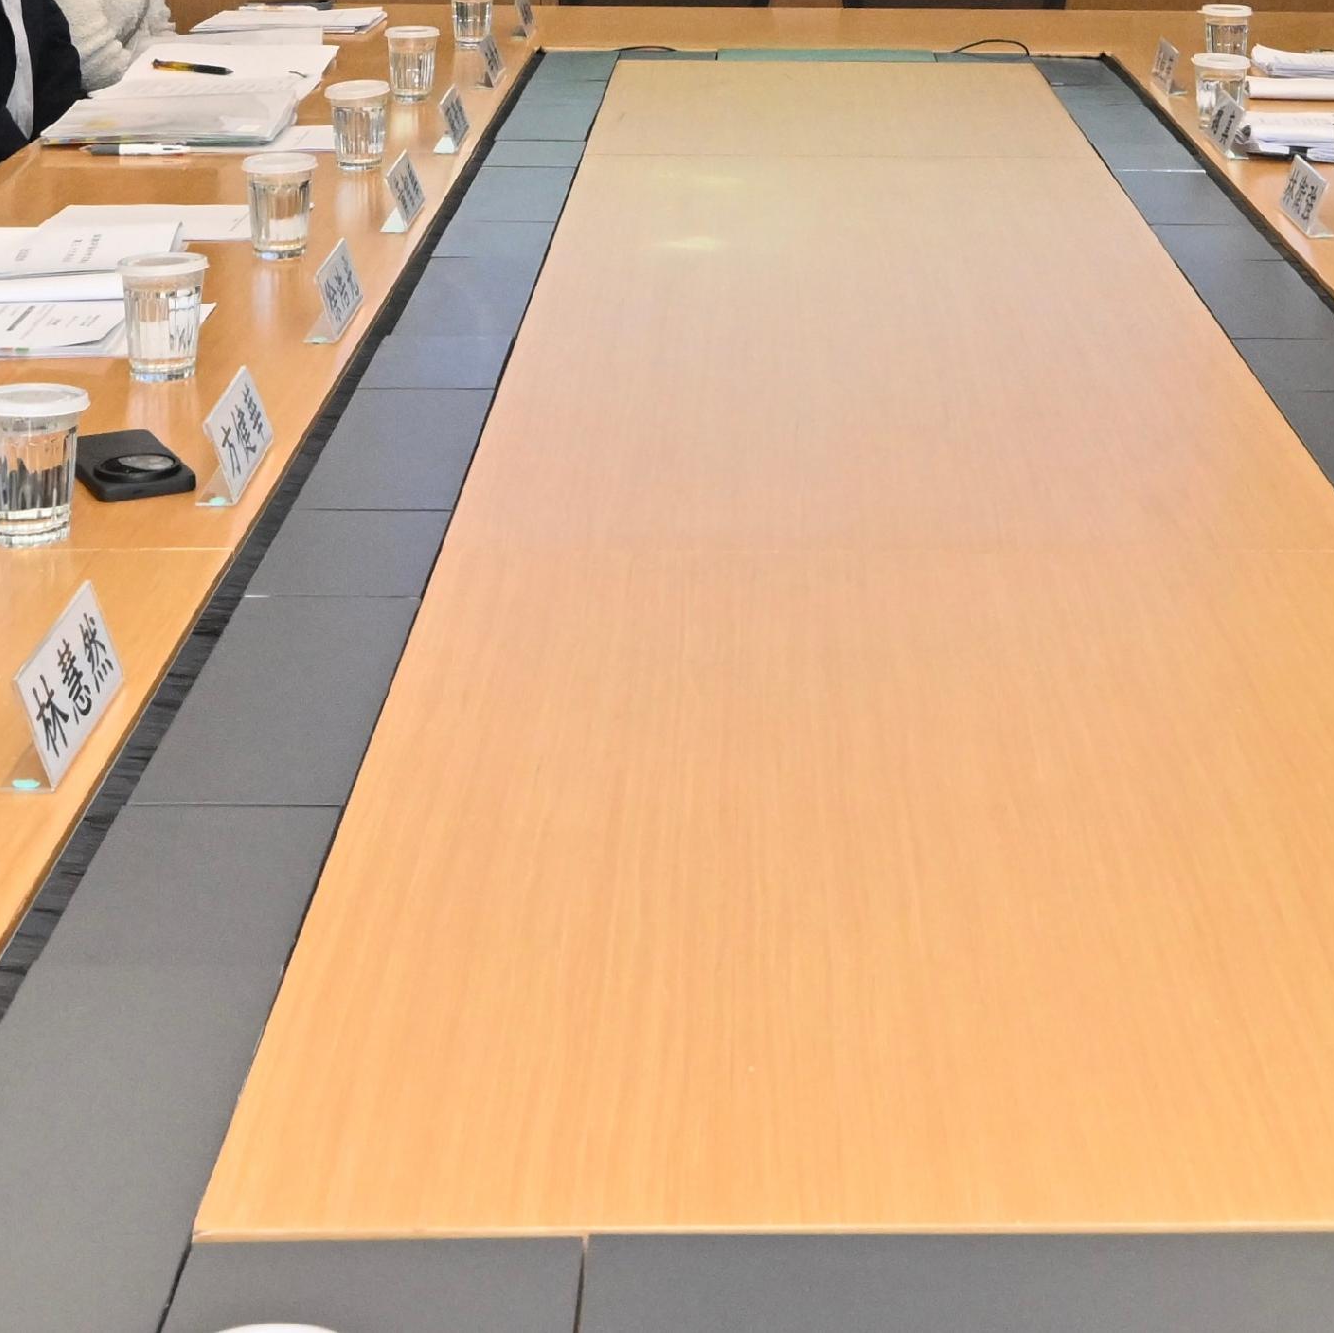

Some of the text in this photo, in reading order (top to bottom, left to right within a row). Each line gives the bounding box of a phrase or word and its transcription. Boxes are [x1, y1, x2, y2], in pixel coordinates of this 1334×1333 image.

[221, 384, 266, 477] 方健華
[32, 612, 114, 759] 林慧然
